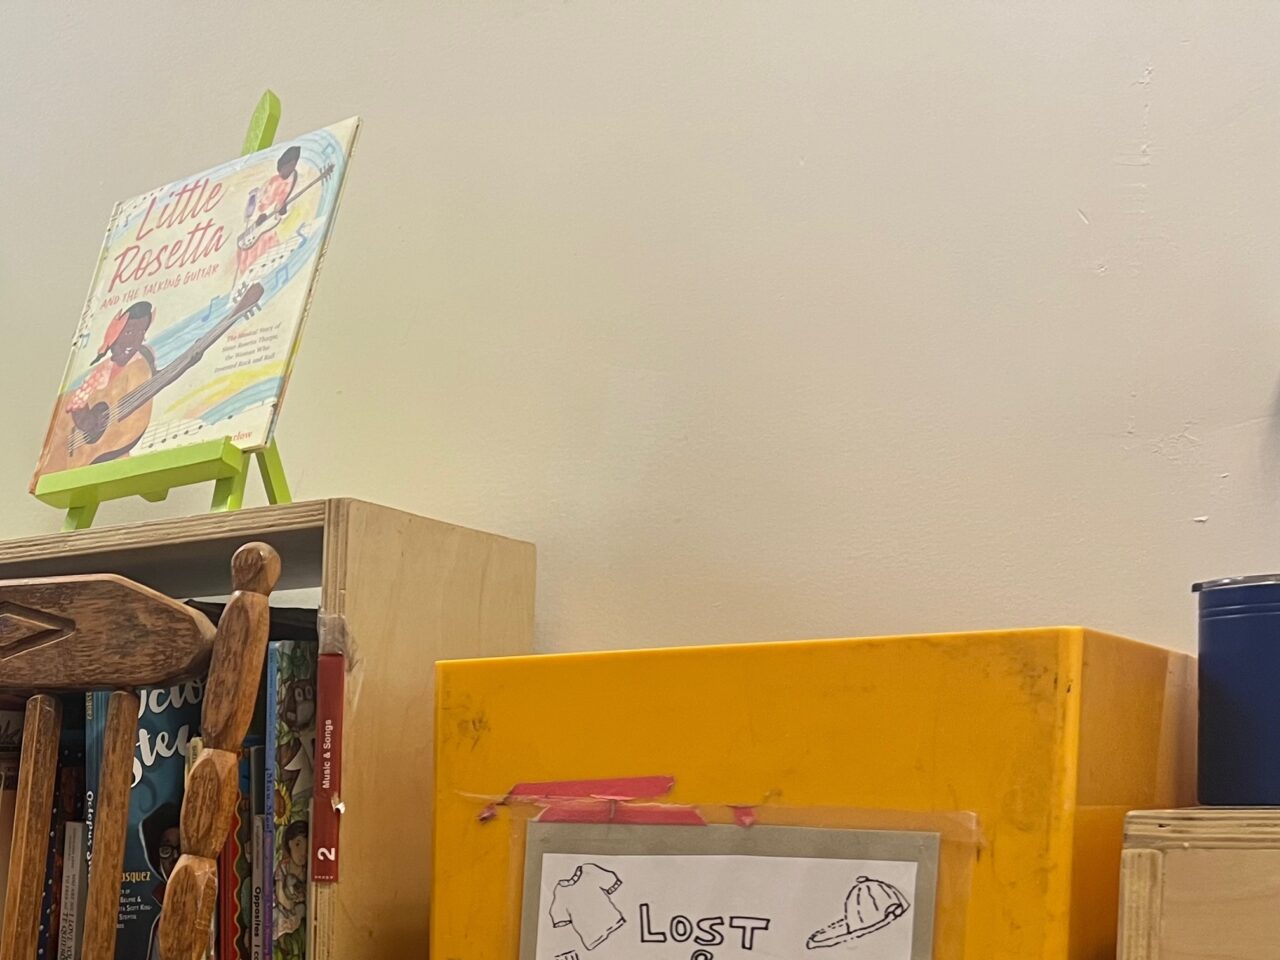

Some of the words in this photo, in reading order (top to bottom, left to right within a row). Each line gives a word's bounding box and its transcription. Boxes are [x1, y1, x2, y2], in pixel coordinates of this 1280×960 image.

[136, 178, 223, 241] Little
[108, 218, 226, 293] Rosetta
[100, 295, 120, 310] AND
[122, 287, 139, 302] THE
[143, 274, 182, 297] TALKING
[183, 263, 220, 285] GUITAR
[322, 719, 333, 749] Songs
[322, 752, 332, 761] &
[321, 763, 331, 789] Music
[85, 790, 95, 841] Octopus
[317, 846, 336, 862] 2
[253, 886, 262, 937] Opposites
[638, 903, 771, 950] LOST
